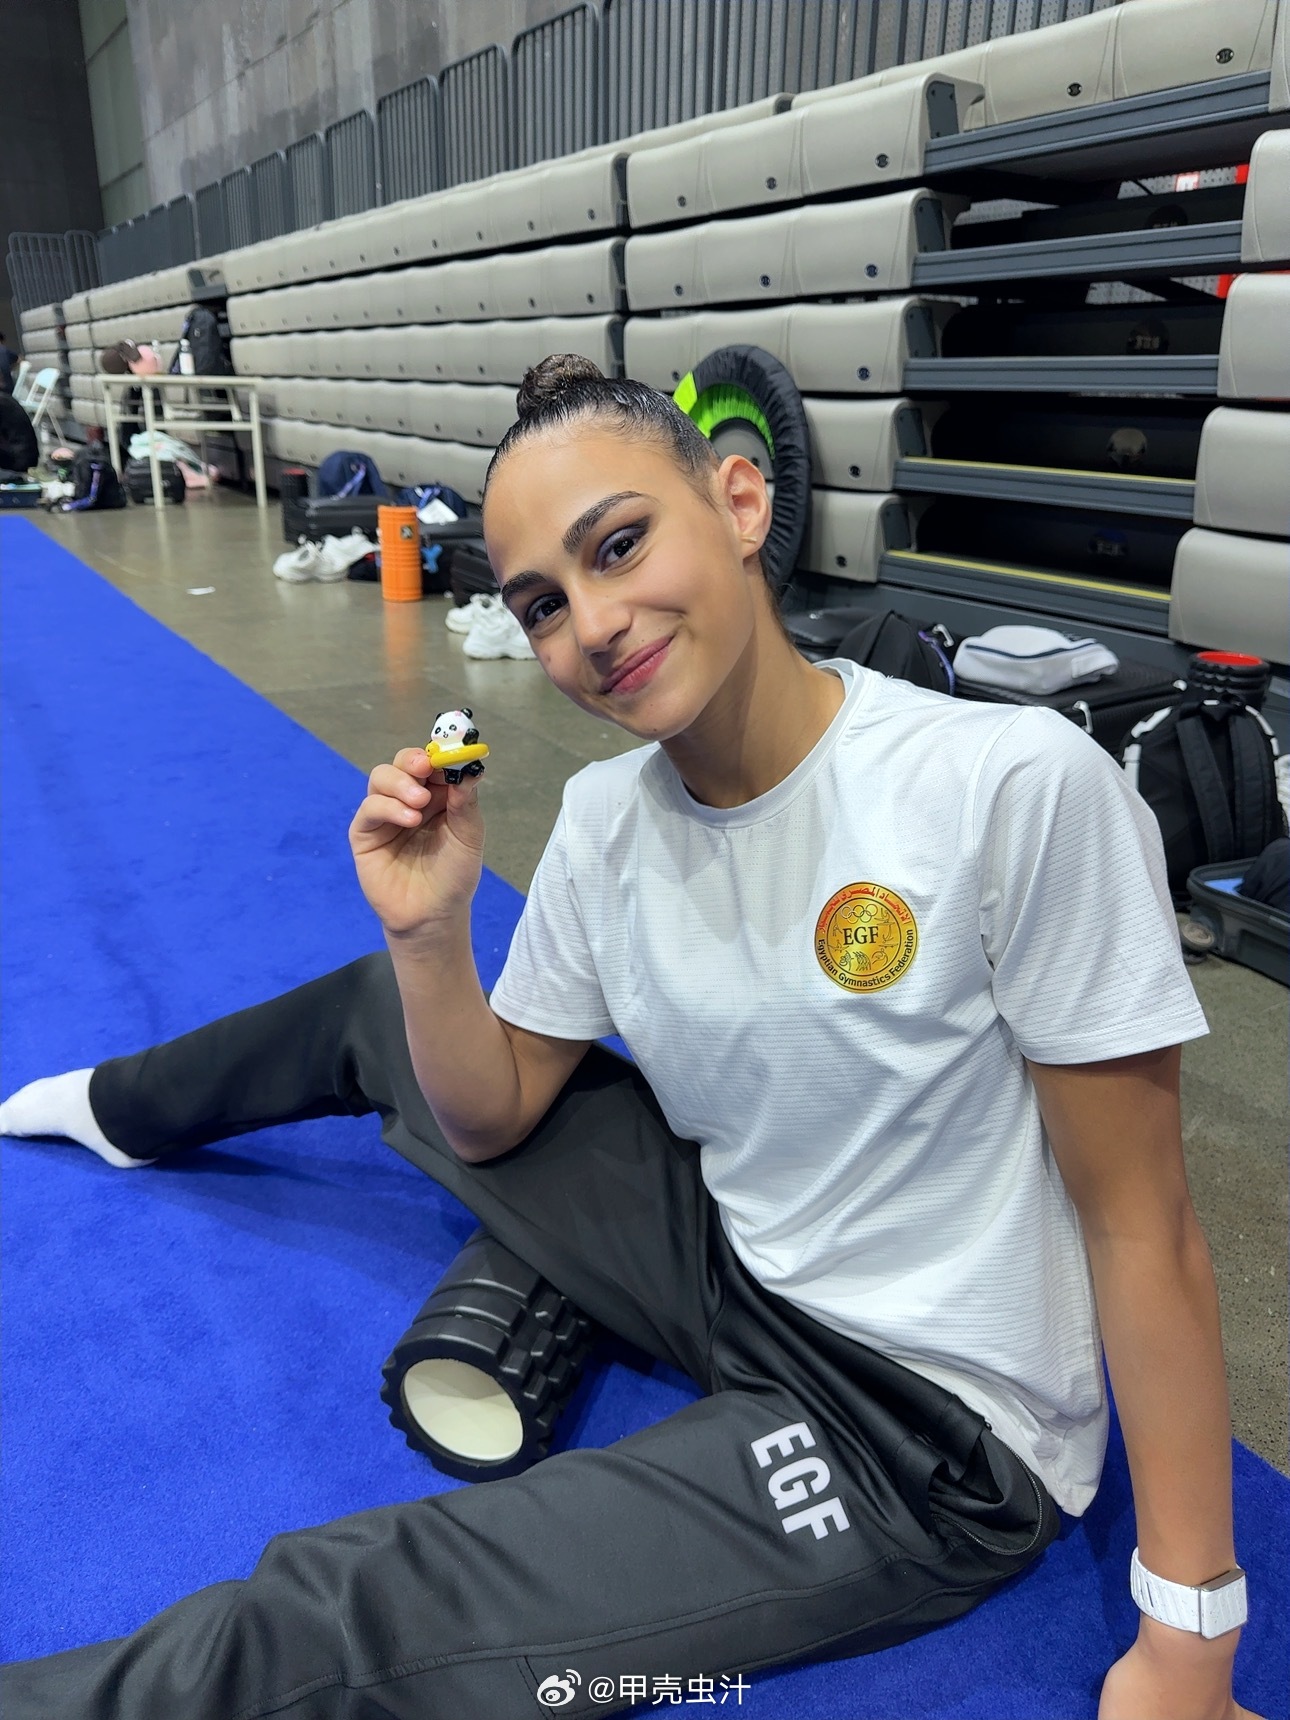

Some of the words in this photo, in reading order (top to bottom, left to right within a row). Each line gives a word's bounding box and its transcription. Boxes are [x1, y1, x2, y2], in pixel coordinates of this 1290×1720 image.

[818, 938, 838, 976] Egyptian
[838, 972, 891, 988] Gymnastics
[888, 929, 914, 977] Federation
[842, 926, 879, 946] EGF
[750, 1421, 851, 1540] EGF
